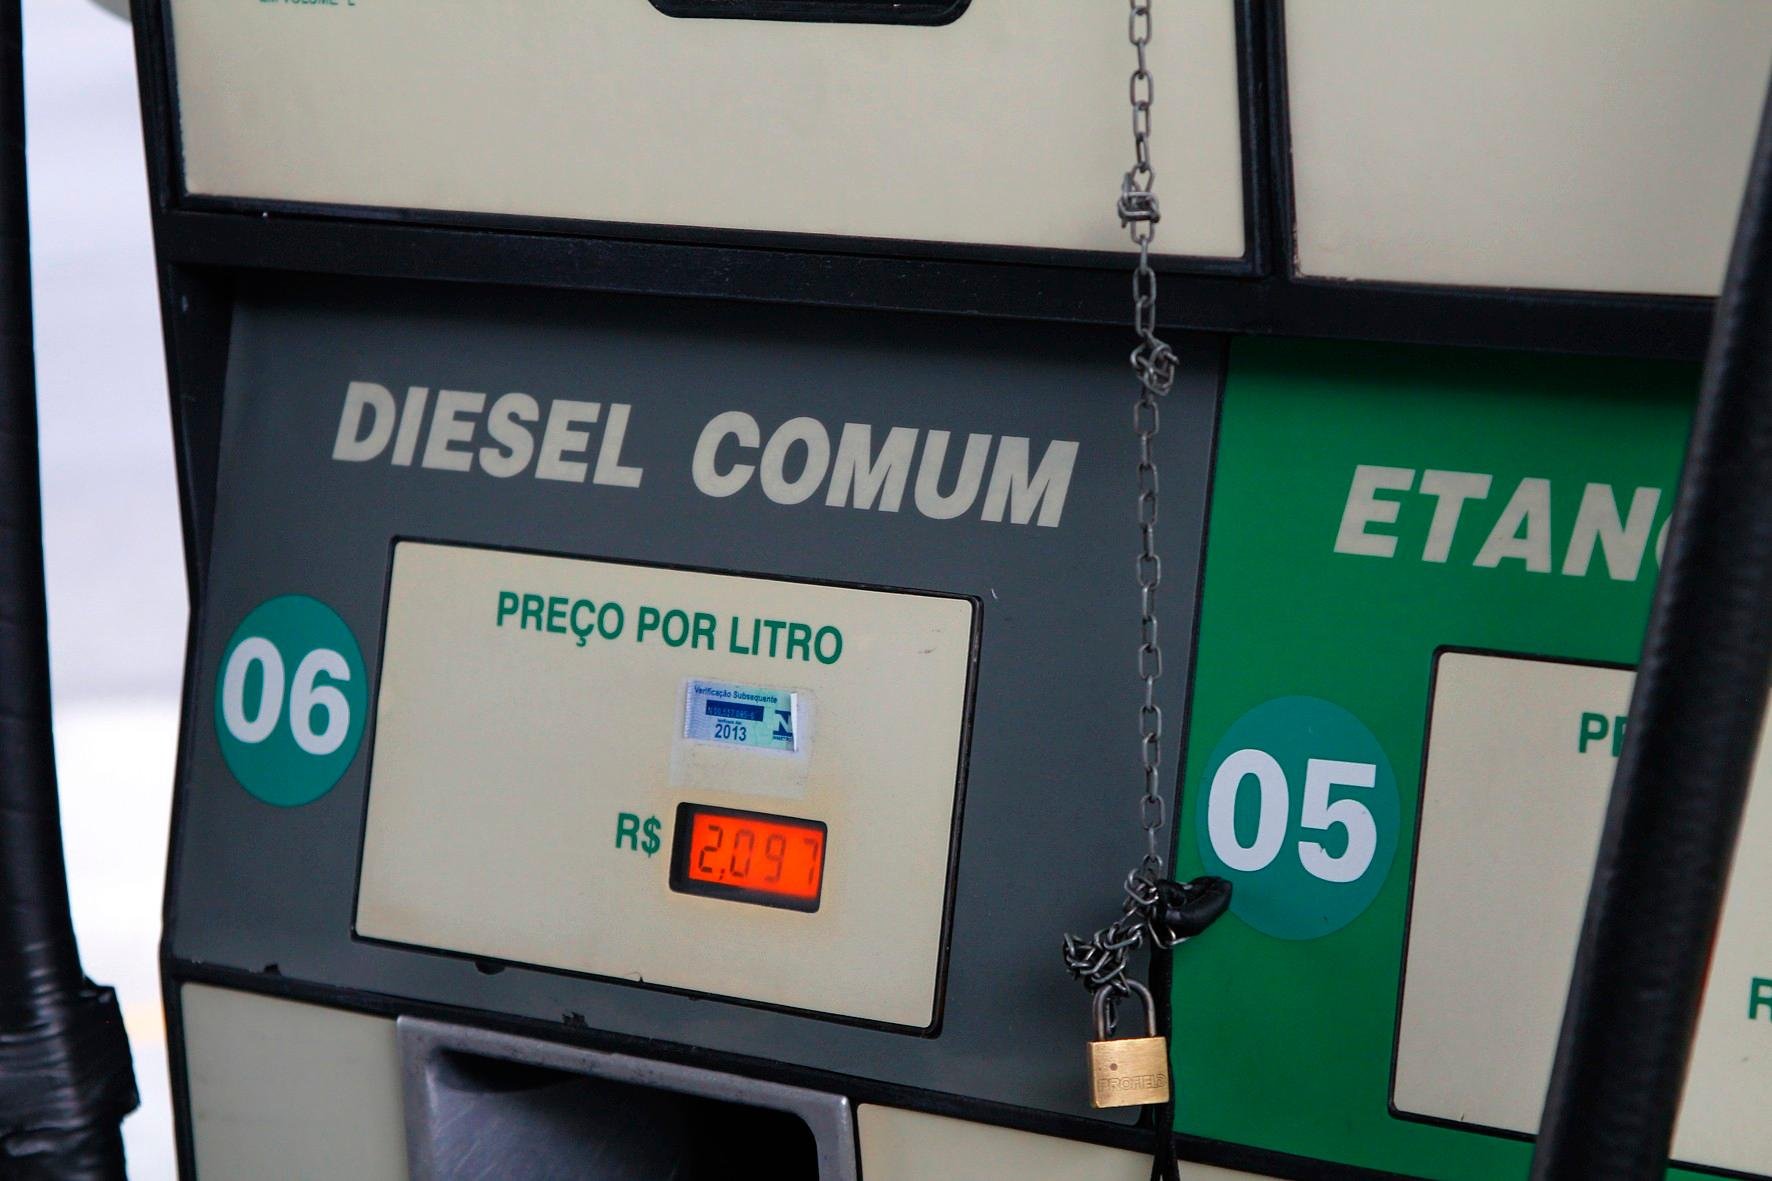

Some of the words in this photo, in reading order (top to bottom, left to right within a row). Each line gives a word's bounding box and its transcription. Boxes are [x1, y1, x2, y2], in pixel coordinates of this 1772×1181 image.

[332, 382, 643, 488] DIESEL
[692, 411, 1079, 528] COMUM
[1334, 464, 1673, 581] ETAN
[497, 590, 625, 648] PREÇO
[636, 605, 718, 651] POR
[729, 615, 844, 665] LITRO
[222, 637, 350, 755] 06
[694, 685, 732, 700] Verificação
[733, 690, 778, 704] Subsequente
[715, 723, 747, 742] 2013
[615, 812, 661, 858] R$
[1207, 748, 1378, 883] 05
[698, 824, 820, 885] 2,097
